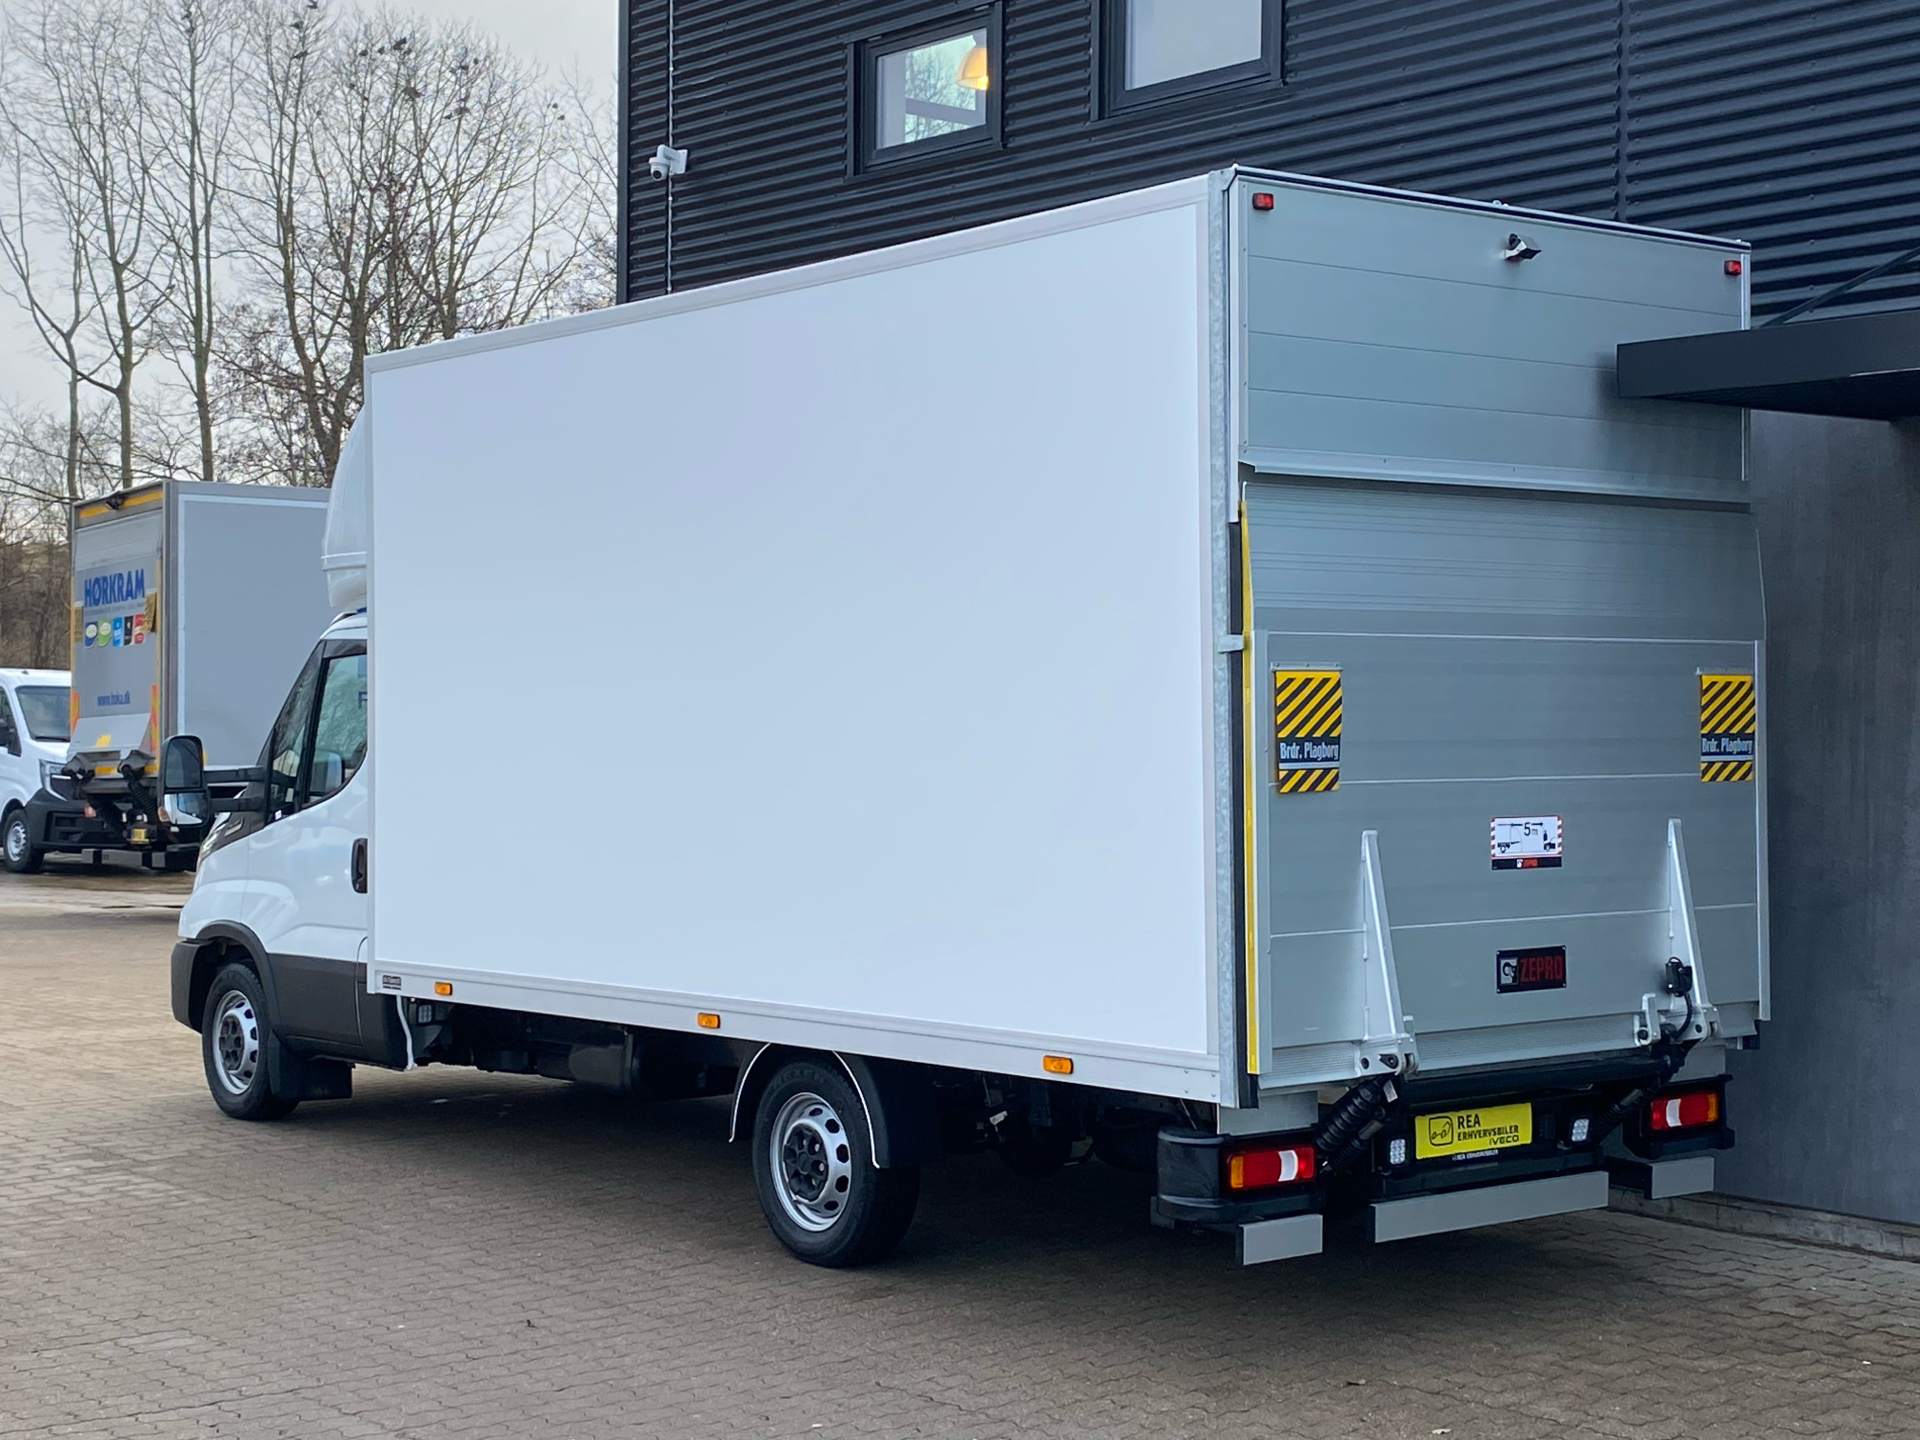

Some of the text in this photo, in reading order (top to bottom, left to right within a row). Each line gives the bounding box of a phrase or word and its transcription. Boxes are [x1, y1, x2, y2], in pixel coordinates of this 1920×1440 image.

[84, 568, 145, 608] HØRKRAM
[1280, 742, 1339, 761] Brdr. Plagborg
[1523, 821, 1531, 836] 5
[1520, 955, 1563, 982] ZEPRO
[1457, 1114, 1481, 1129] REA
[1489, 1135, 1520, 1145] IVECO
